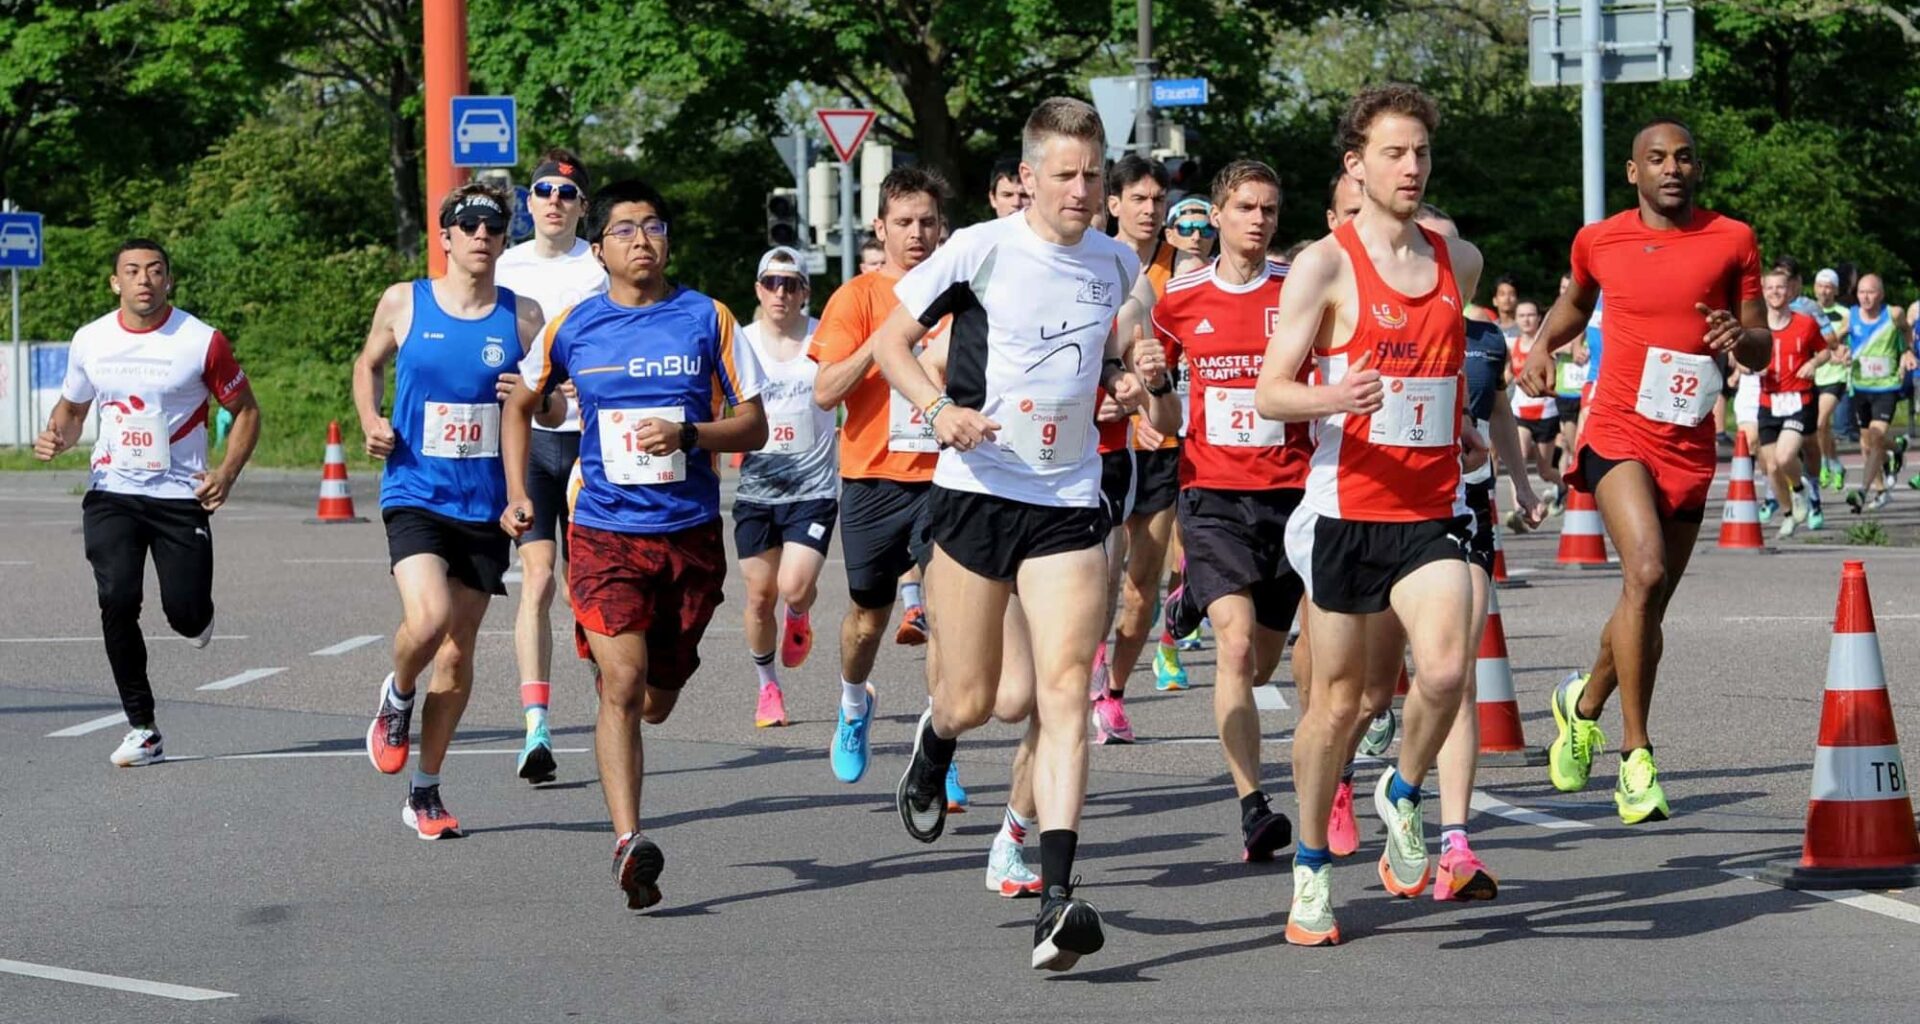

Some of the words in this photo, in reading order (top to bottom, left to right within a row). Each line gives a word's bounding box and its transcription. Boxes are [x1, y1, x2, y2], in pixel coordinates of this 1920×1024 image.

[1155, 85, 1203, 101] Brauerstr.
[1377, 342, 1418, 359] SWE
[628, 355, 701, 377] EnBW
[1253, 355, 1264, 367] P
[1200, 368, 1241, 380] GRATIS
[1670, 374, 1699, 397] 32
[1672, 396, 1688, 409] 32
[1231, 410, 1255, 430] 21
[1414, 403, 1425, 426] 1
[121, 431, 153, 447] 260
[444, 423, 481, 442] 210
[773, 426, 795, 442] 26
[921, 427, 934, 437] 32
[1042, 423, 1057, 446] 9
[1237, 432, 1250, 443] 32
[1409, 429, 1424, 441] 32
[131, 449, 143, 457] 32
[636, 454, 651, 466] 32
[1039, 448, 1054, 461] 32
